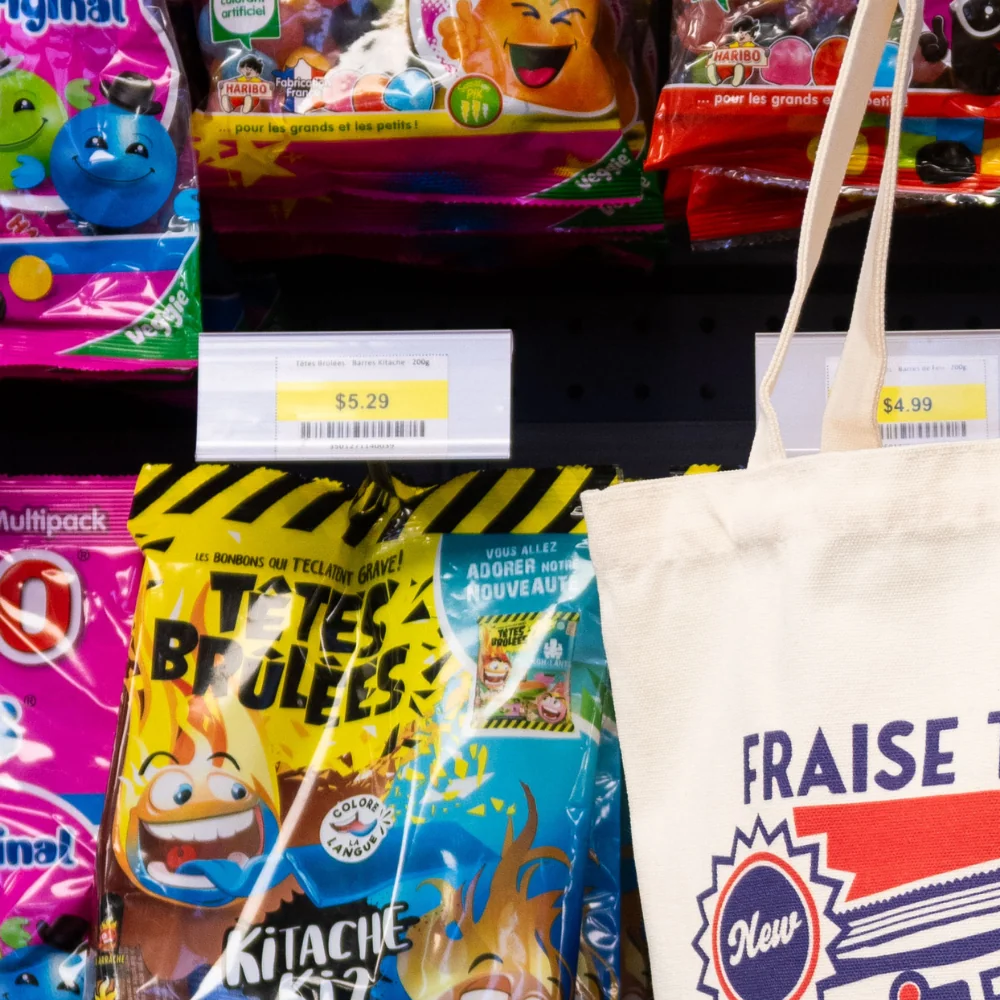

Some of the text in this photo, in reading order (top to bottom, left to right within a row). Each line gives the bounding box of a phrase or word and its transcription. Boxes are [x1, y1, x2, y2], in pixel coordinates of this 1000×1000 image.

[0, 0, 127, 33] iginal
[222, 6, 266, 19] artificiel
[713, 50, 762, 62] HARIBO
[226, 83, 267, 95] HARIBO
[714, 92, 819, 108] pour les grands
[235, 122, 265, 135] pour
[268, 120, 286, 133] les
[290, 119, 334, 135] grands
[338, 121, 350, 132] et
[354, 119, 374, 131] les
[412, 358, 430, 367] 200g
[335, 392, 389, 411] $5.29
[883, 397, 932, 414] $4.99
[486, 541, 557, 559] VOUS ALLEZ
[195, 552, 209, 562] LES
[213, 551, 265, 568] BONBONS
[268, 556, 288, 569] QUI
[357, 549, 404, 584] GRAVE!
[466, 558, 536, 580] ADORER
[209, 570, 400, 659] TÊTES
[743, 716, 959, 804] FRAISE
[332, 797, 380, 818] COLORE
[327, 834, 378, 858] LANGUE
[348, 838, 360, 847] LA
[727, 910, 802, 966] New
